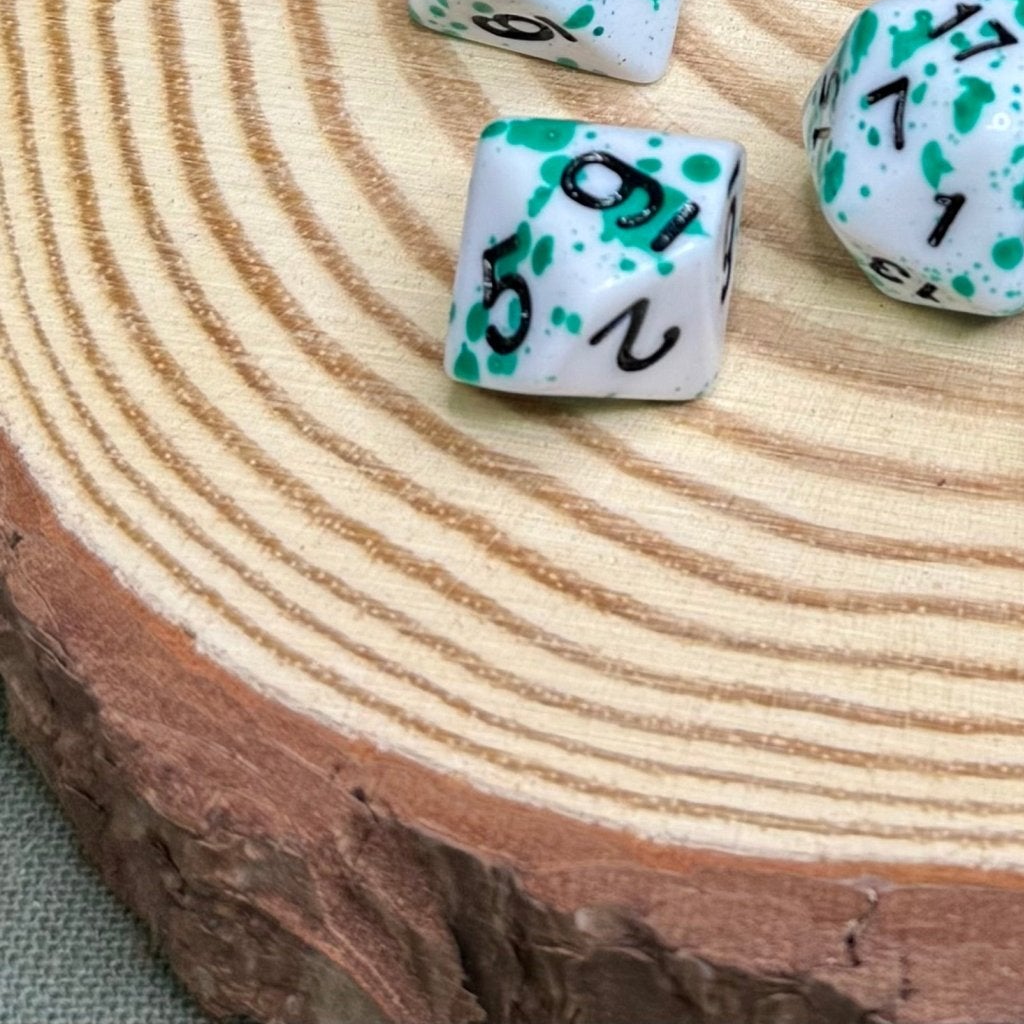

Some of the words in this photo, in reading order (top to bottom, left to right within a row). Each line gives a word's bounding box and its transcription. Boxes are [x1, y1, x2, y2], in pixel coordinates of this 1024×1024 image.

[928, 3, 1018, 62] 17
[866, 76, 910, 151] 7
[927, 193, 967, 248] 1
[483, 233, 532, 355] 5
[589, 297, 681, 372] 2
